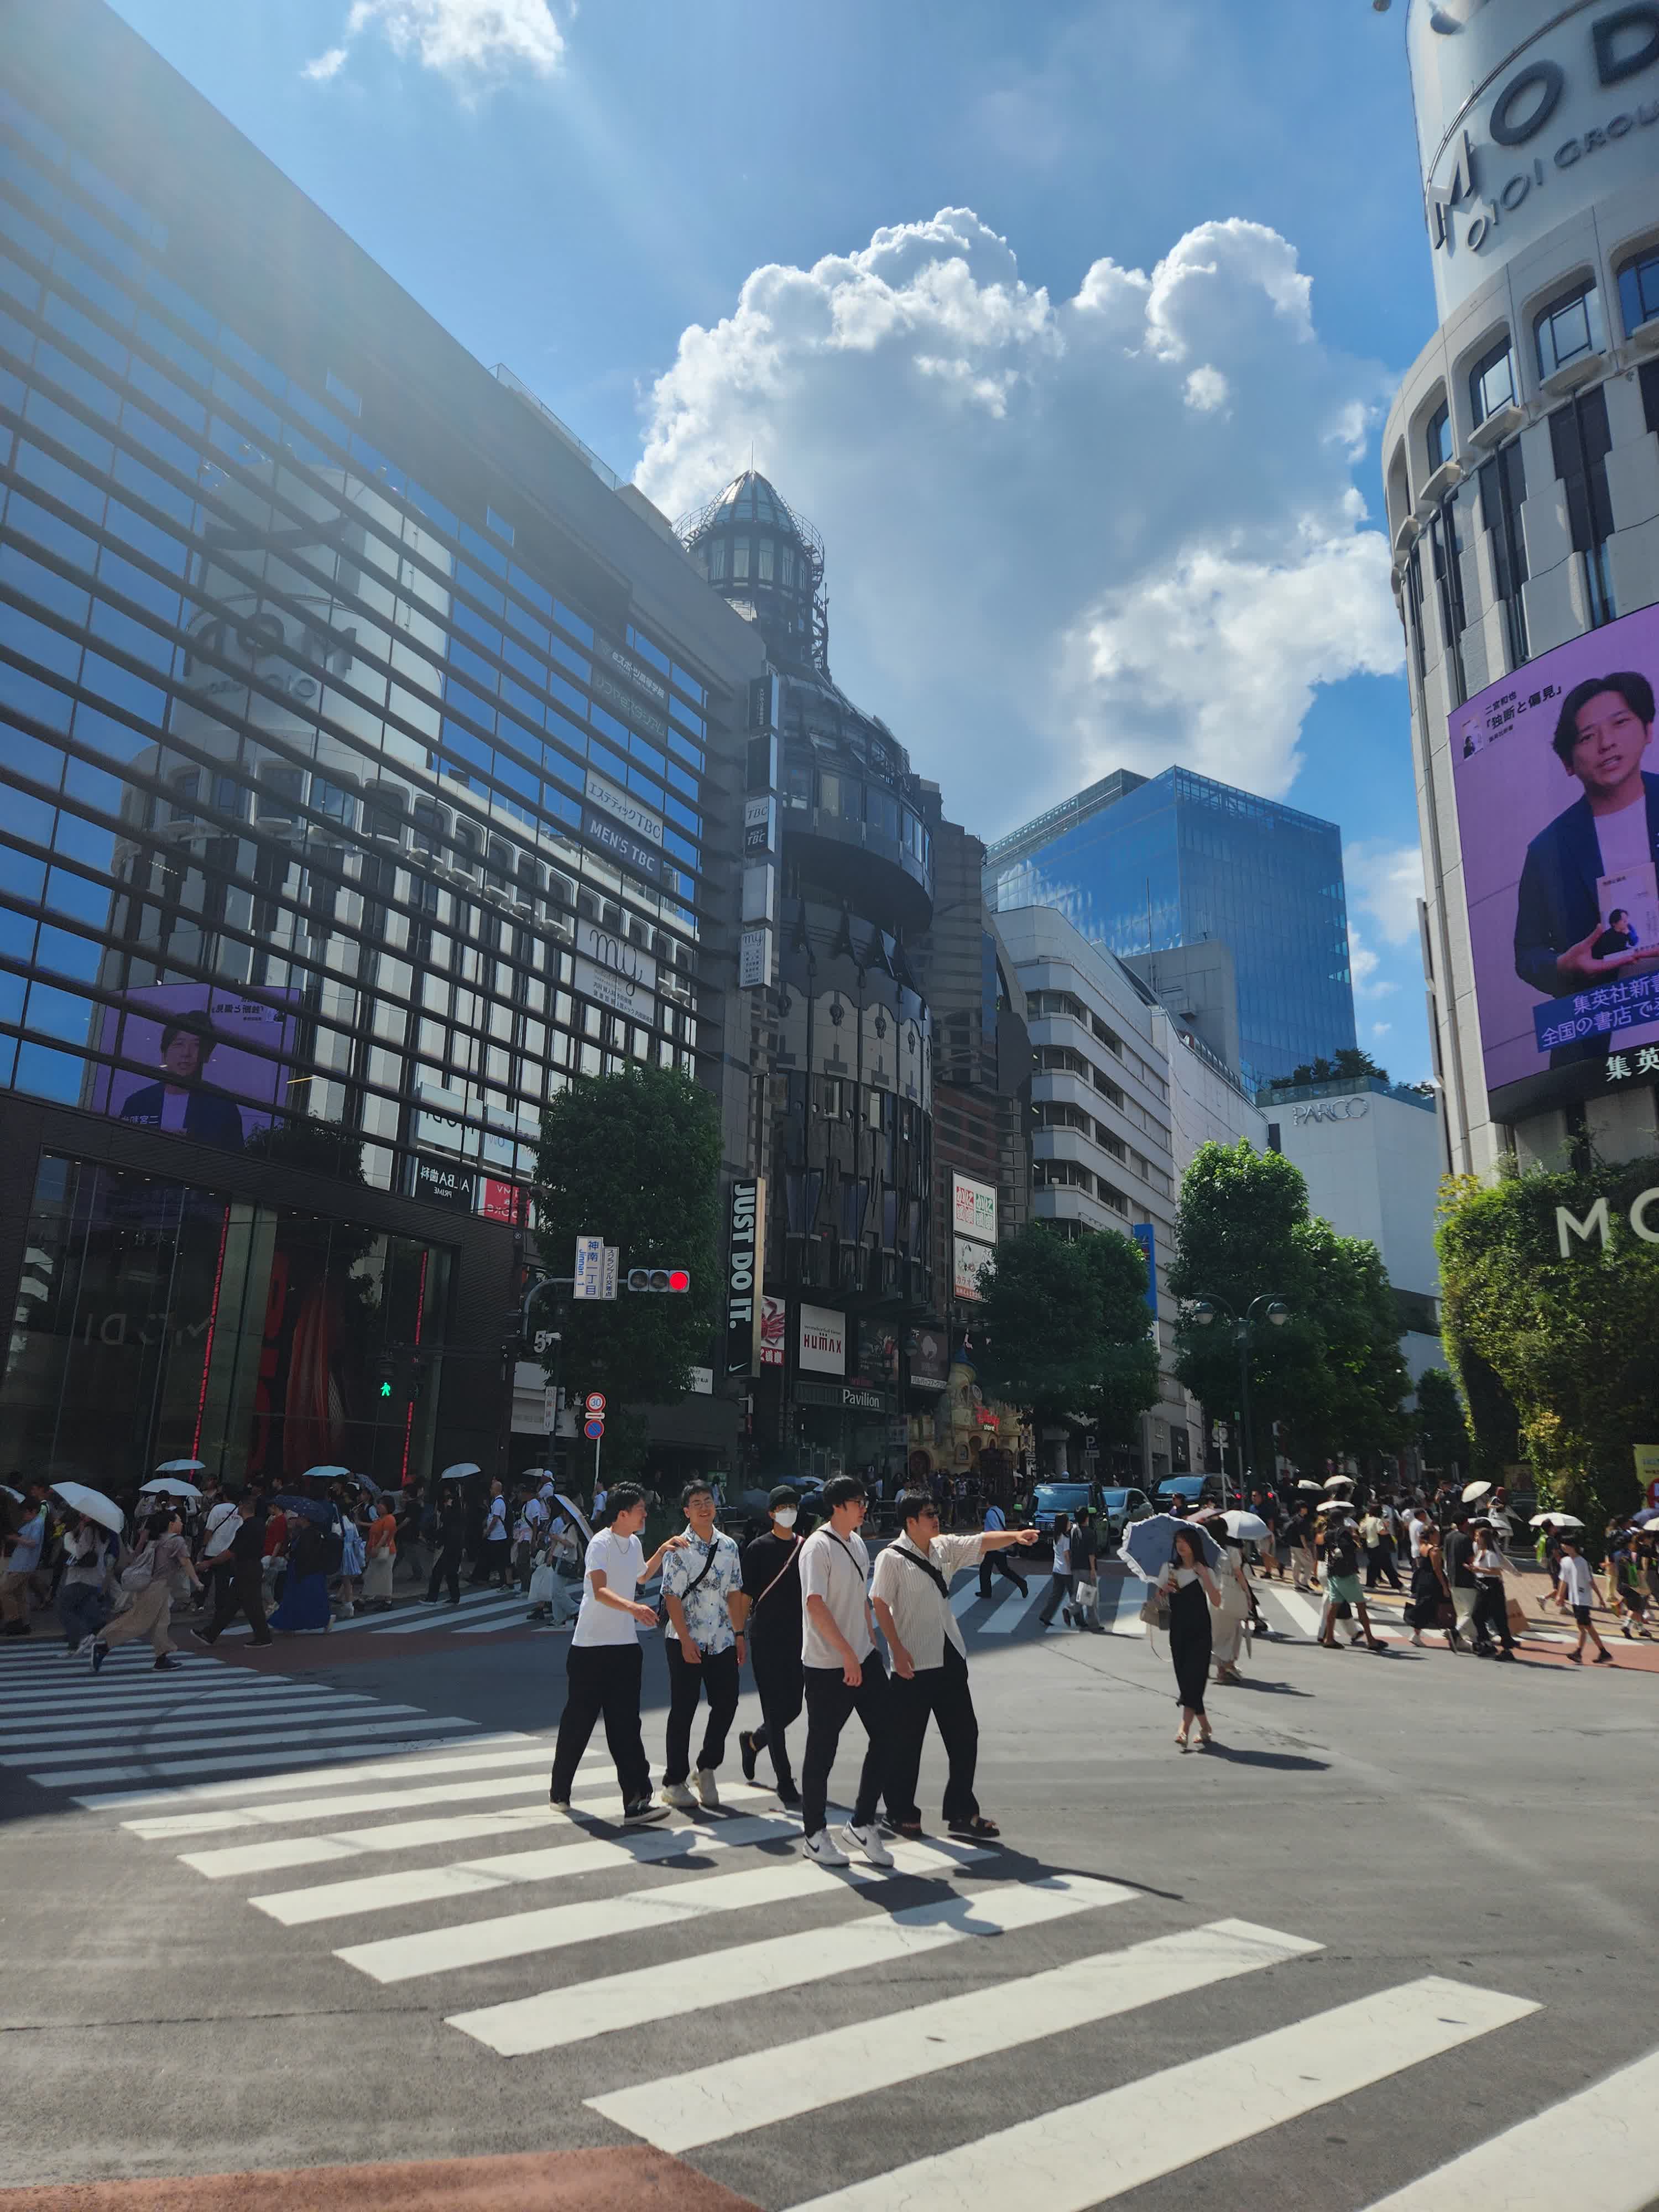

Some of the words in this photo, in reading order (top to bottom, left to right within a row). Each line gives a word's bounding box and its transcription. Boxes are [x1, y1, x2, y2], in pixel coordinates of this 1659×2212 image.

[589, 819, 629, 854] MEN'S
[632, 845, 655, 872] TBC
[747, 832, 766, 846] TBC
[1541, 998, 1659, 1047] 全国の書店で
[1292, 1097, 1368, 1127] PARCO
[732, 1183, 755, 1244] JUST
[586, 1240, 599, 1295] 神南一丁目
[731, 1251, 754, 1291] DO
[729, 1297, 752, 1329] IT.
[804, 1332, 842, 1354] HUMAX
[590, 1397, 602, 1407] 30
[842, 1388, 880, 1408] Pavilion
